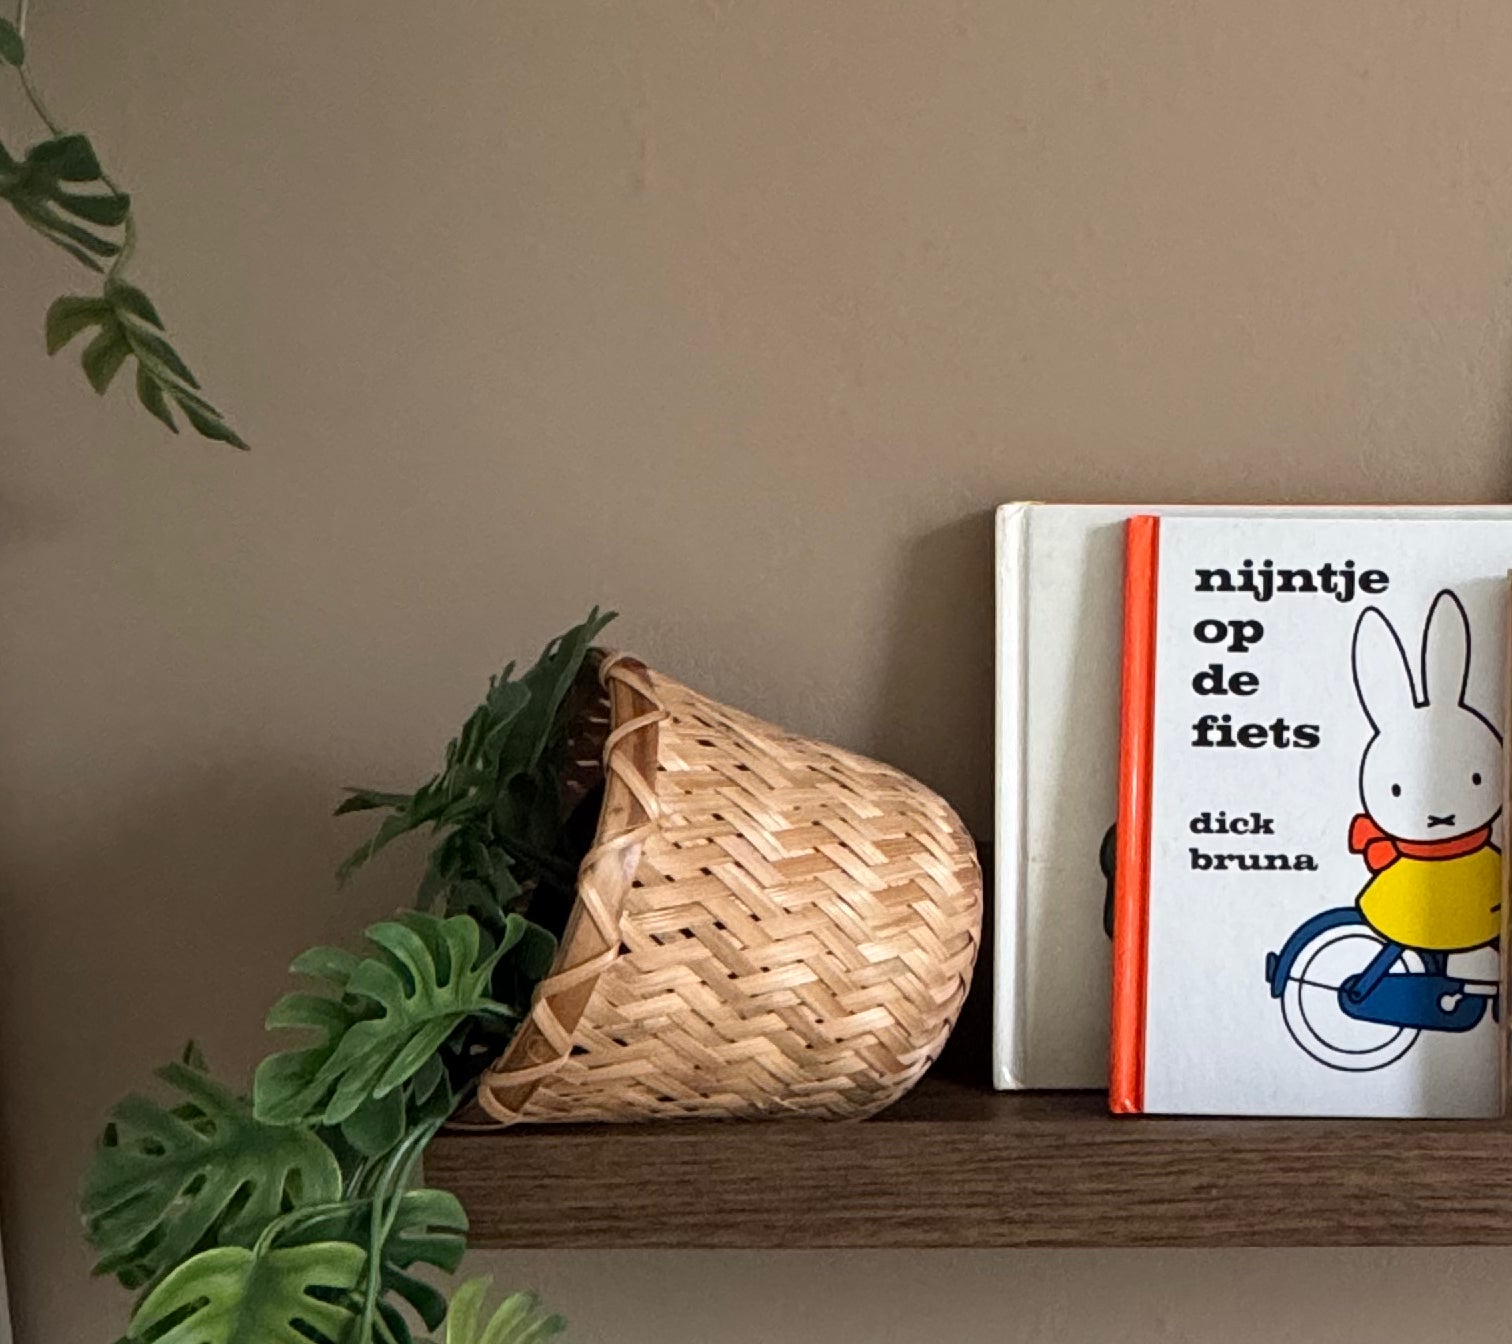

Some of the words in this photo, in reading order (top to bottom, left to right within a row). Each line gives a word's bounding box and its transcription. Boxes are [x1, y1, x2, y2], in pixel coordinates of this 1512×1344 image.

[1194, 558, 1390, 603] nijntje
[1193, 618, 1264, 653] op
[1192, 663, 1260, 696] de
[1191, 714, 1320, 749] fiets
[1189, 810, 1275, 836] dick
[1188, 847, 1319, 872] bruna
